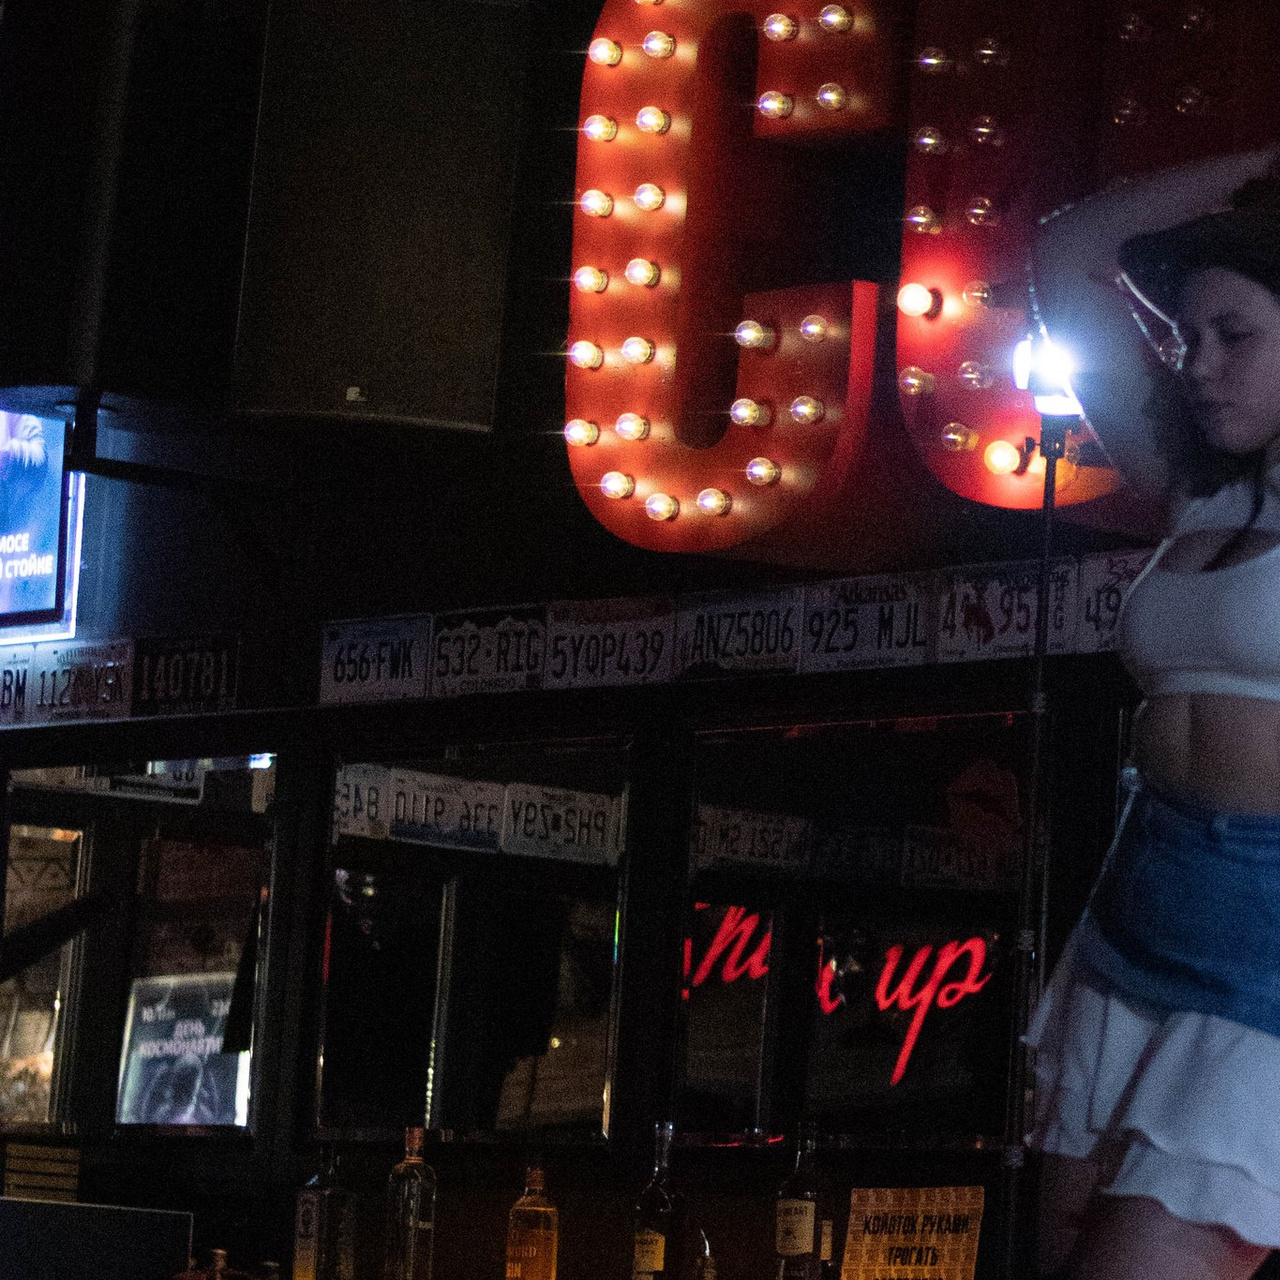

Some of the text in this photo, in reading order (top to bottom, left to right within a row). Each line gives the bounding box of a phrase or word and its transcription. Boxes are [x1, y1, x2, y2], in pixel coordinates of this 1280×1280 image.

[808, 607, 858, 652] 925
[875, 935, 993, 1087] up
[887, 1246, 939, 1266] ТРОГАТЬ
